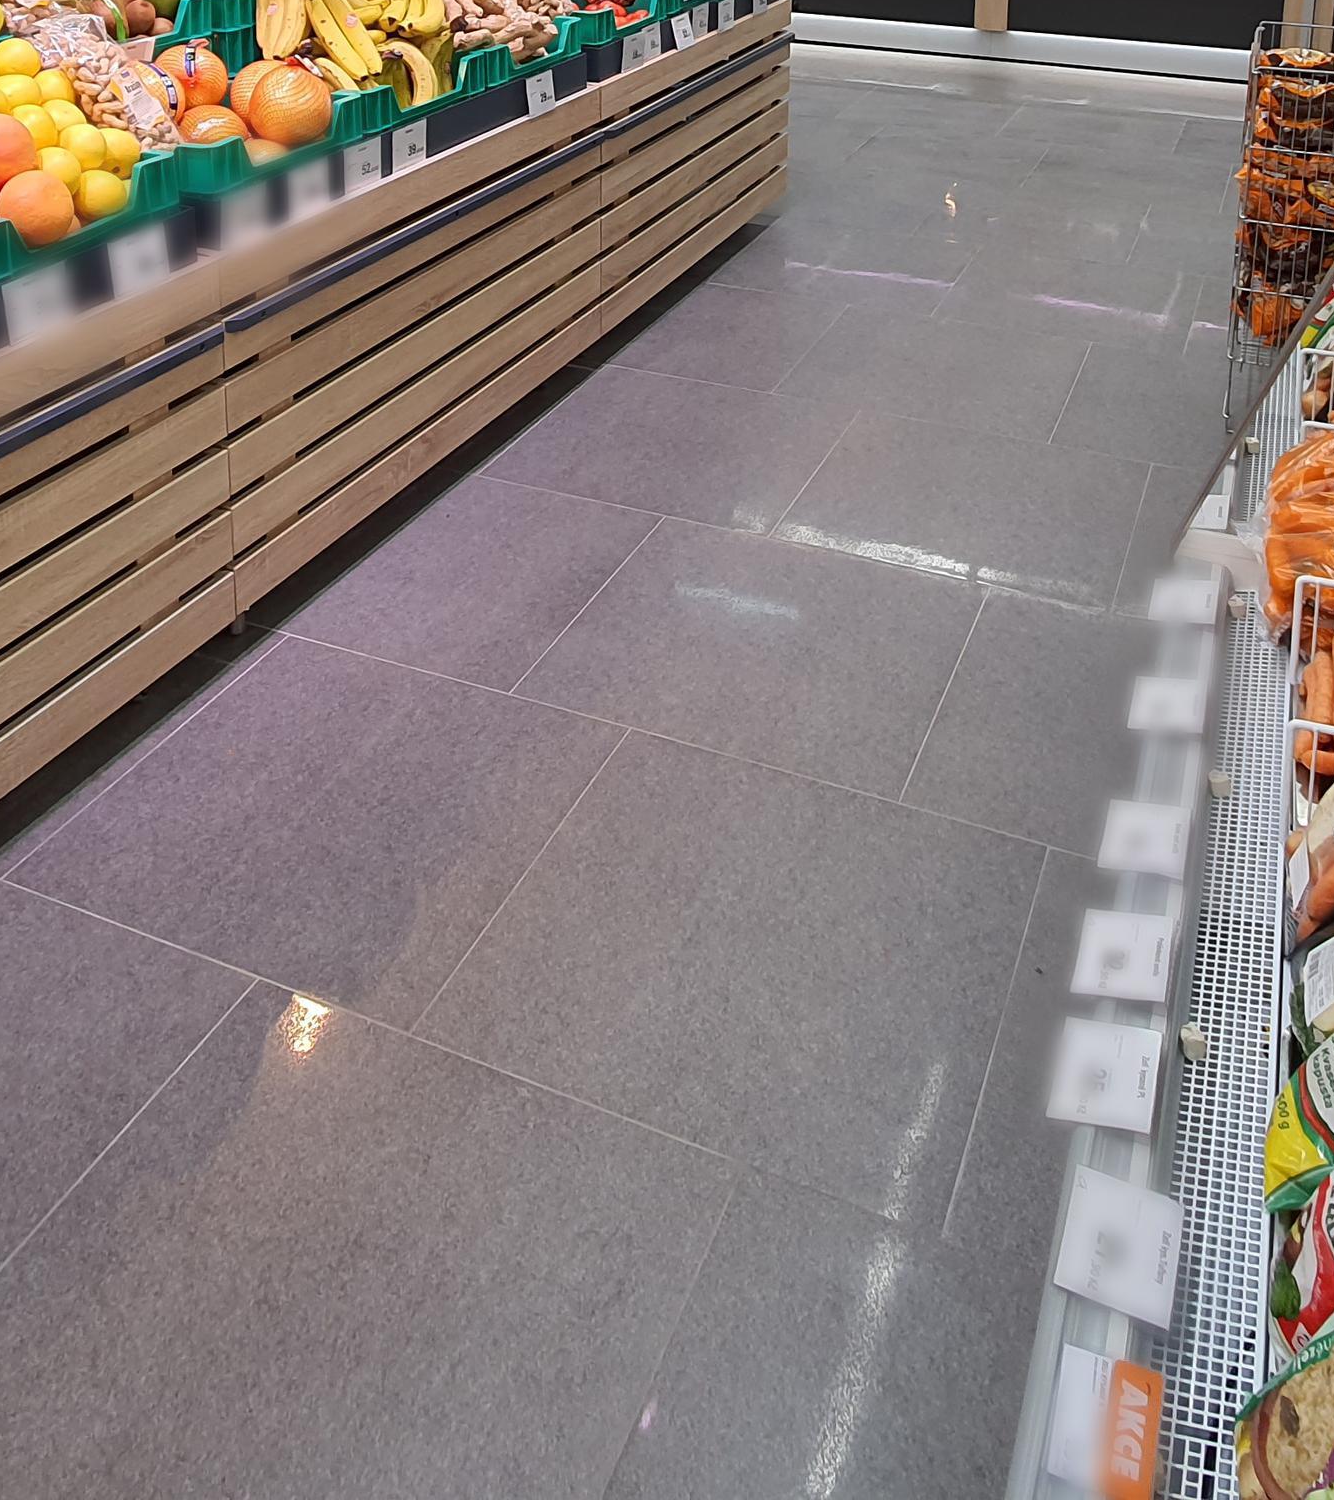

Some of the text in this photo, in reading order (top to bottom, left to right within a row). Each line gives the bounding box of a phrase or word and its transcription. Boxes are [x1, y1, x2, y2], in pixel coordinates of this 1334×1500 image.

[540, 91, 547, 103] 29
[407, 143, 417, 157] 39
[362, 160, 371, 175] 52
[1313, 1053, 1333, 1109] kapusta
[1110, 1379, 1149, 1482] AKCE
